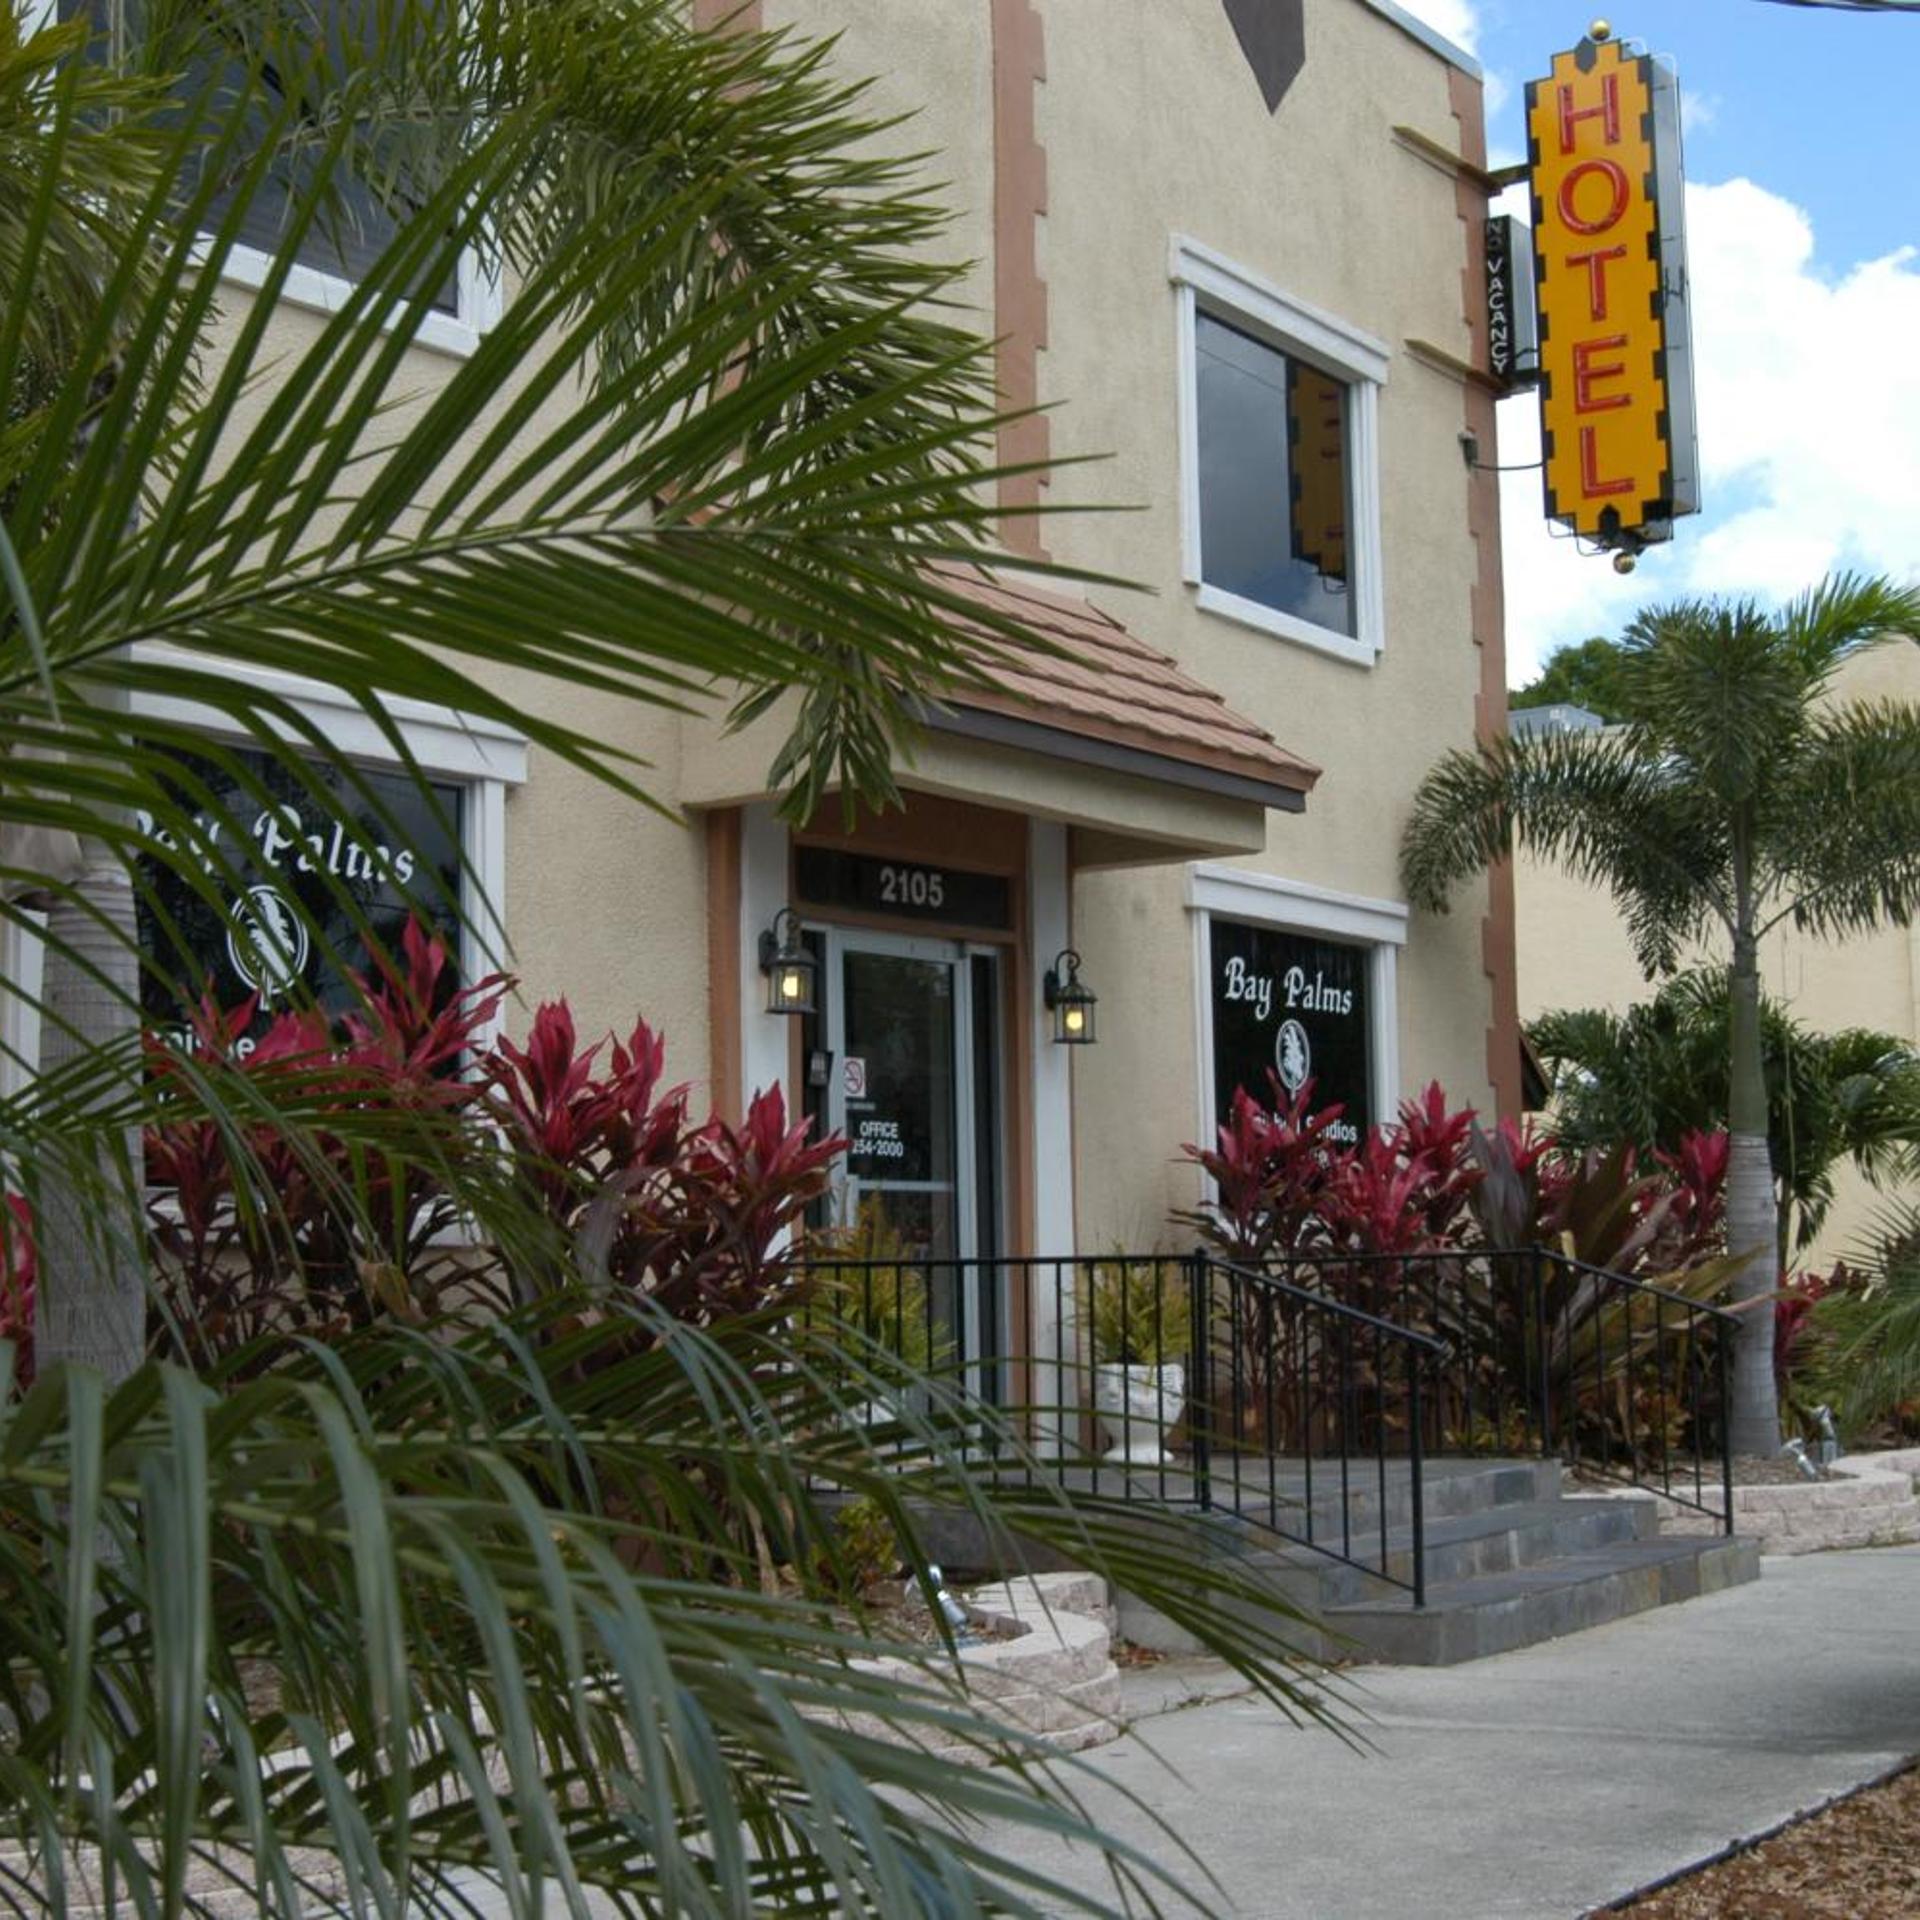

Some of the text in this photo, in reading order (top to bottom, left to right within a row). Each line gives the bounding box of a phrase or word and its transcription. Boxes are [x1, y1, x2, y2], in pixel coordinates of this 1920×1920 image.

[1487, 258, 1508, 374] VACANCY
[1557, 73, 1635, 499] HOTEL
[253, 804, 414, 884] Palms
[880, 866, 943, 906] 2105
[1225, 956, 1353, 1020] Bay Palms
[860, 1120, 899, 1138] OFFICE
